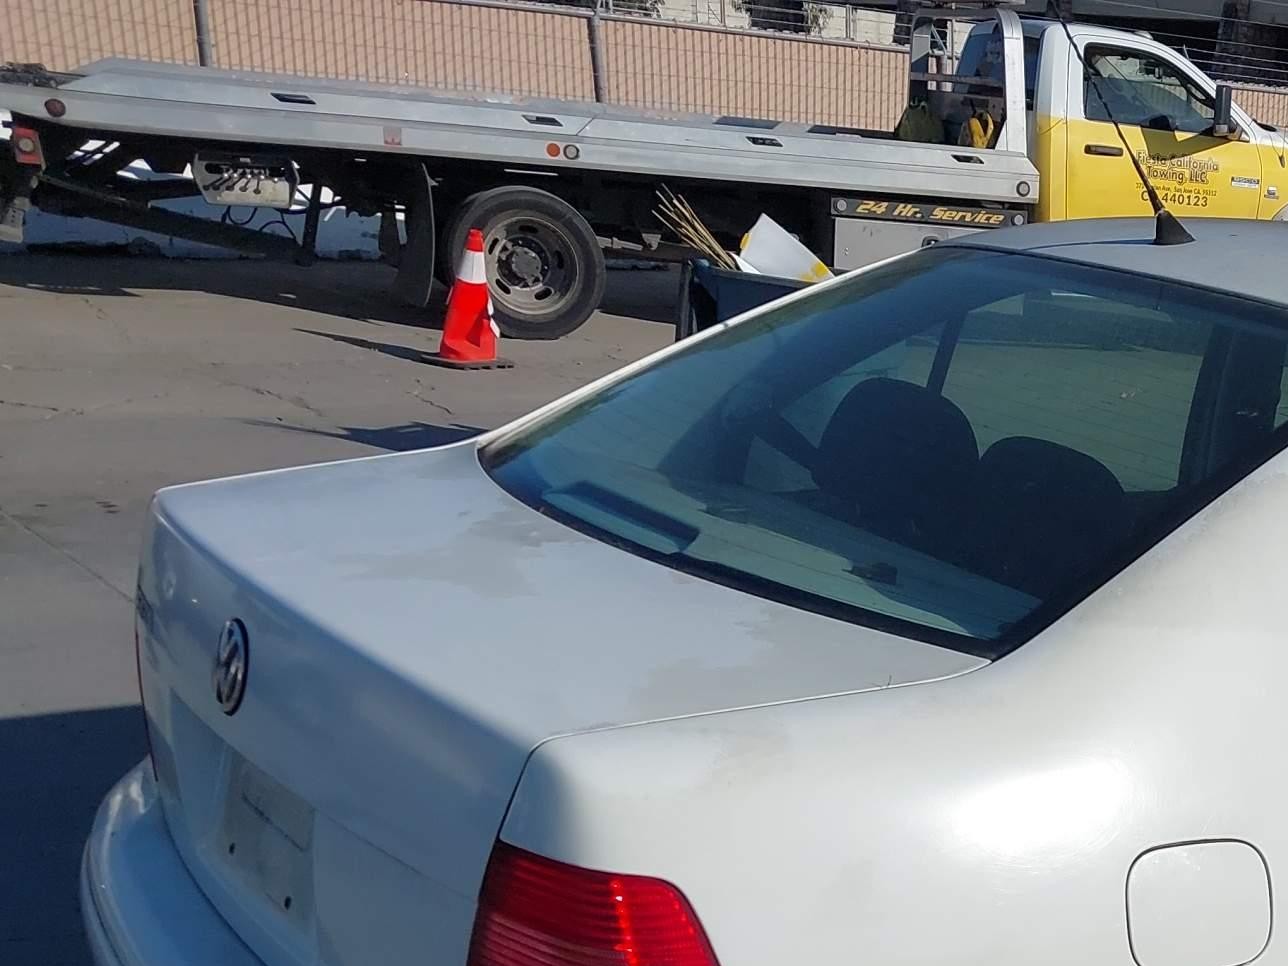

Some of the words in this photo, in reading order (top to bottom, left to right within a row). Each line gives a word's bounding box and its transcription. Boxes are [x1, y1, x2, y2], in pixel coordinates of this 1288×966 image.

[1136, 151, 1167, 166] Fiesta
[1169, 153, 1219, 171] California
[1162, 192, 1208, 207] 440123
[856, 200, 889, 214] 24
[892, 202, 923, 218] Hr.
[929, 207, 1005, 225] Service
